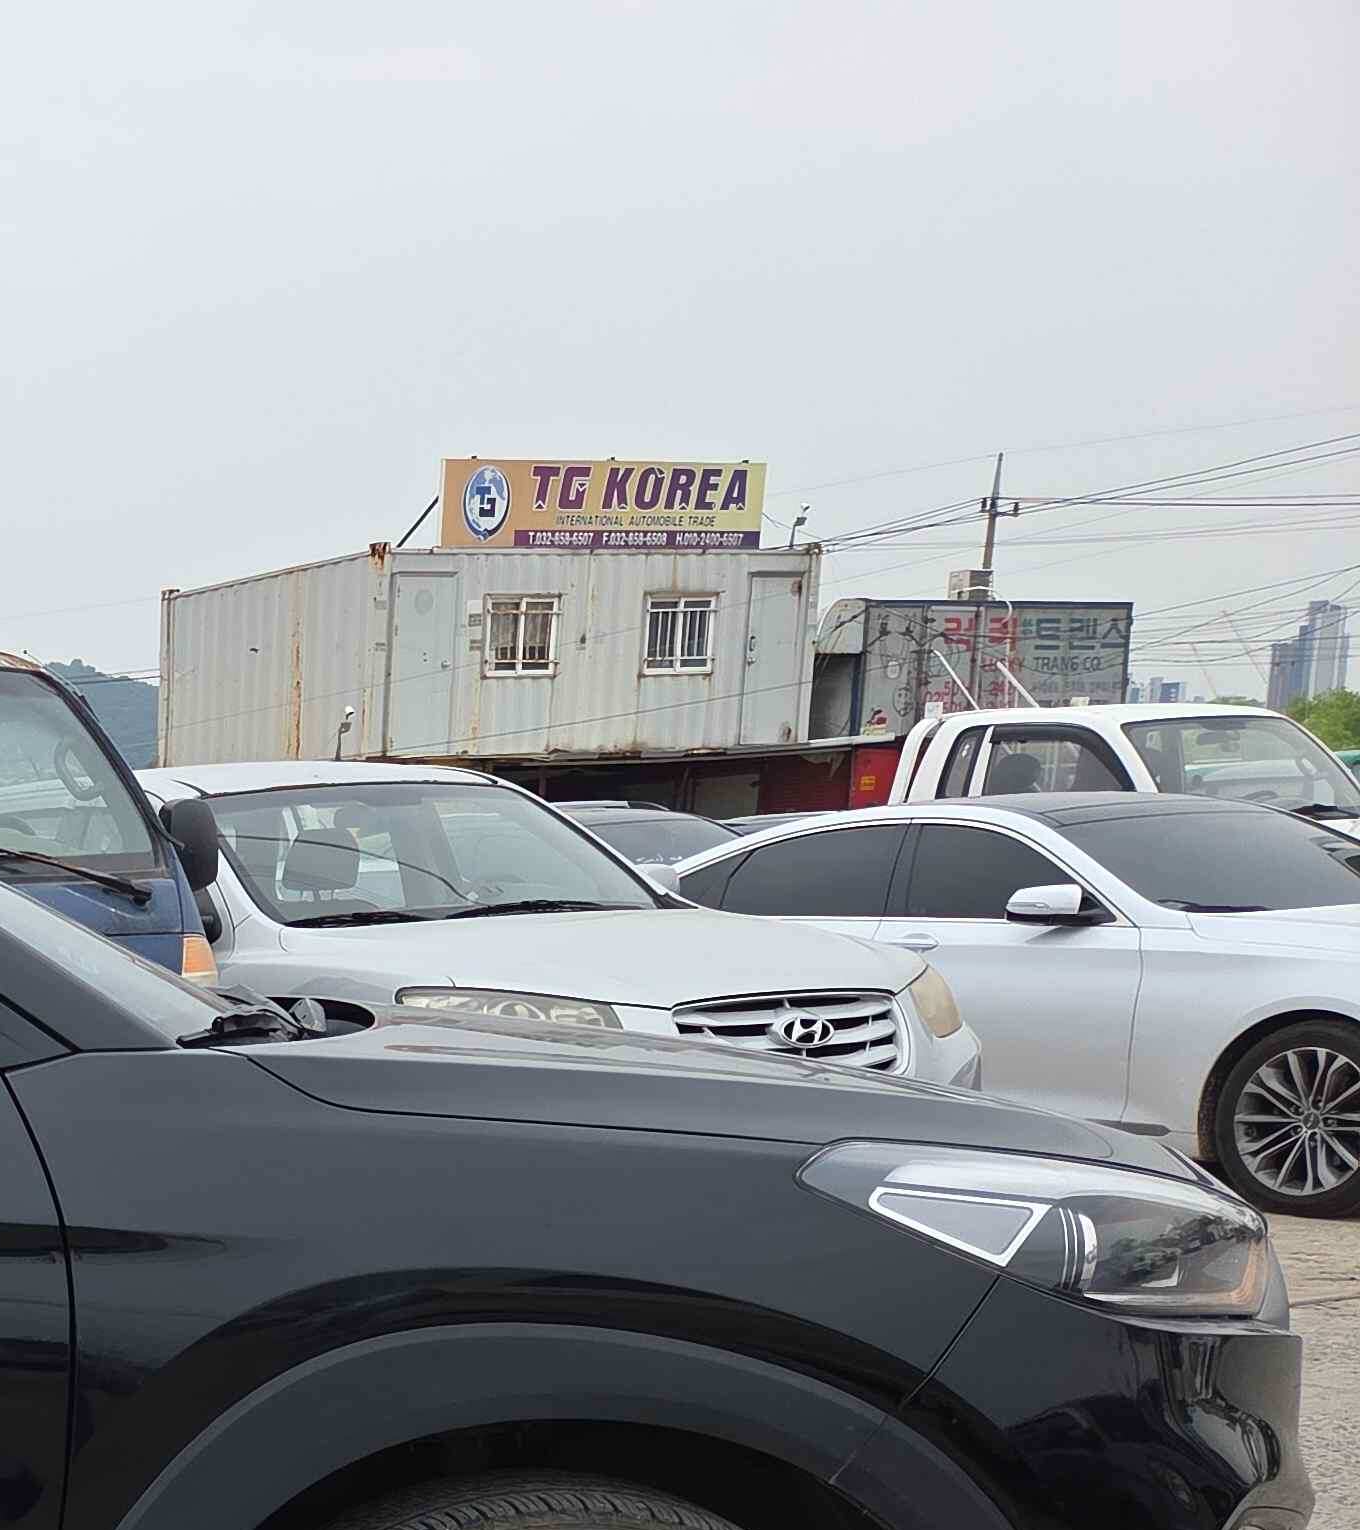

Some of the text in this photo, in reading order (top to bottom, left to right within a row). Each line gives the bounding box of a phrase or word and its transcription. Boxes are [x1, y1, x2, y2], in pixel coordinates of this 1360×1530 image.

[532, 465, 750, 511] TG KOREA
[555, 515, 717, 527] INTERNATIONAL AUTOMOBILE TRADE
